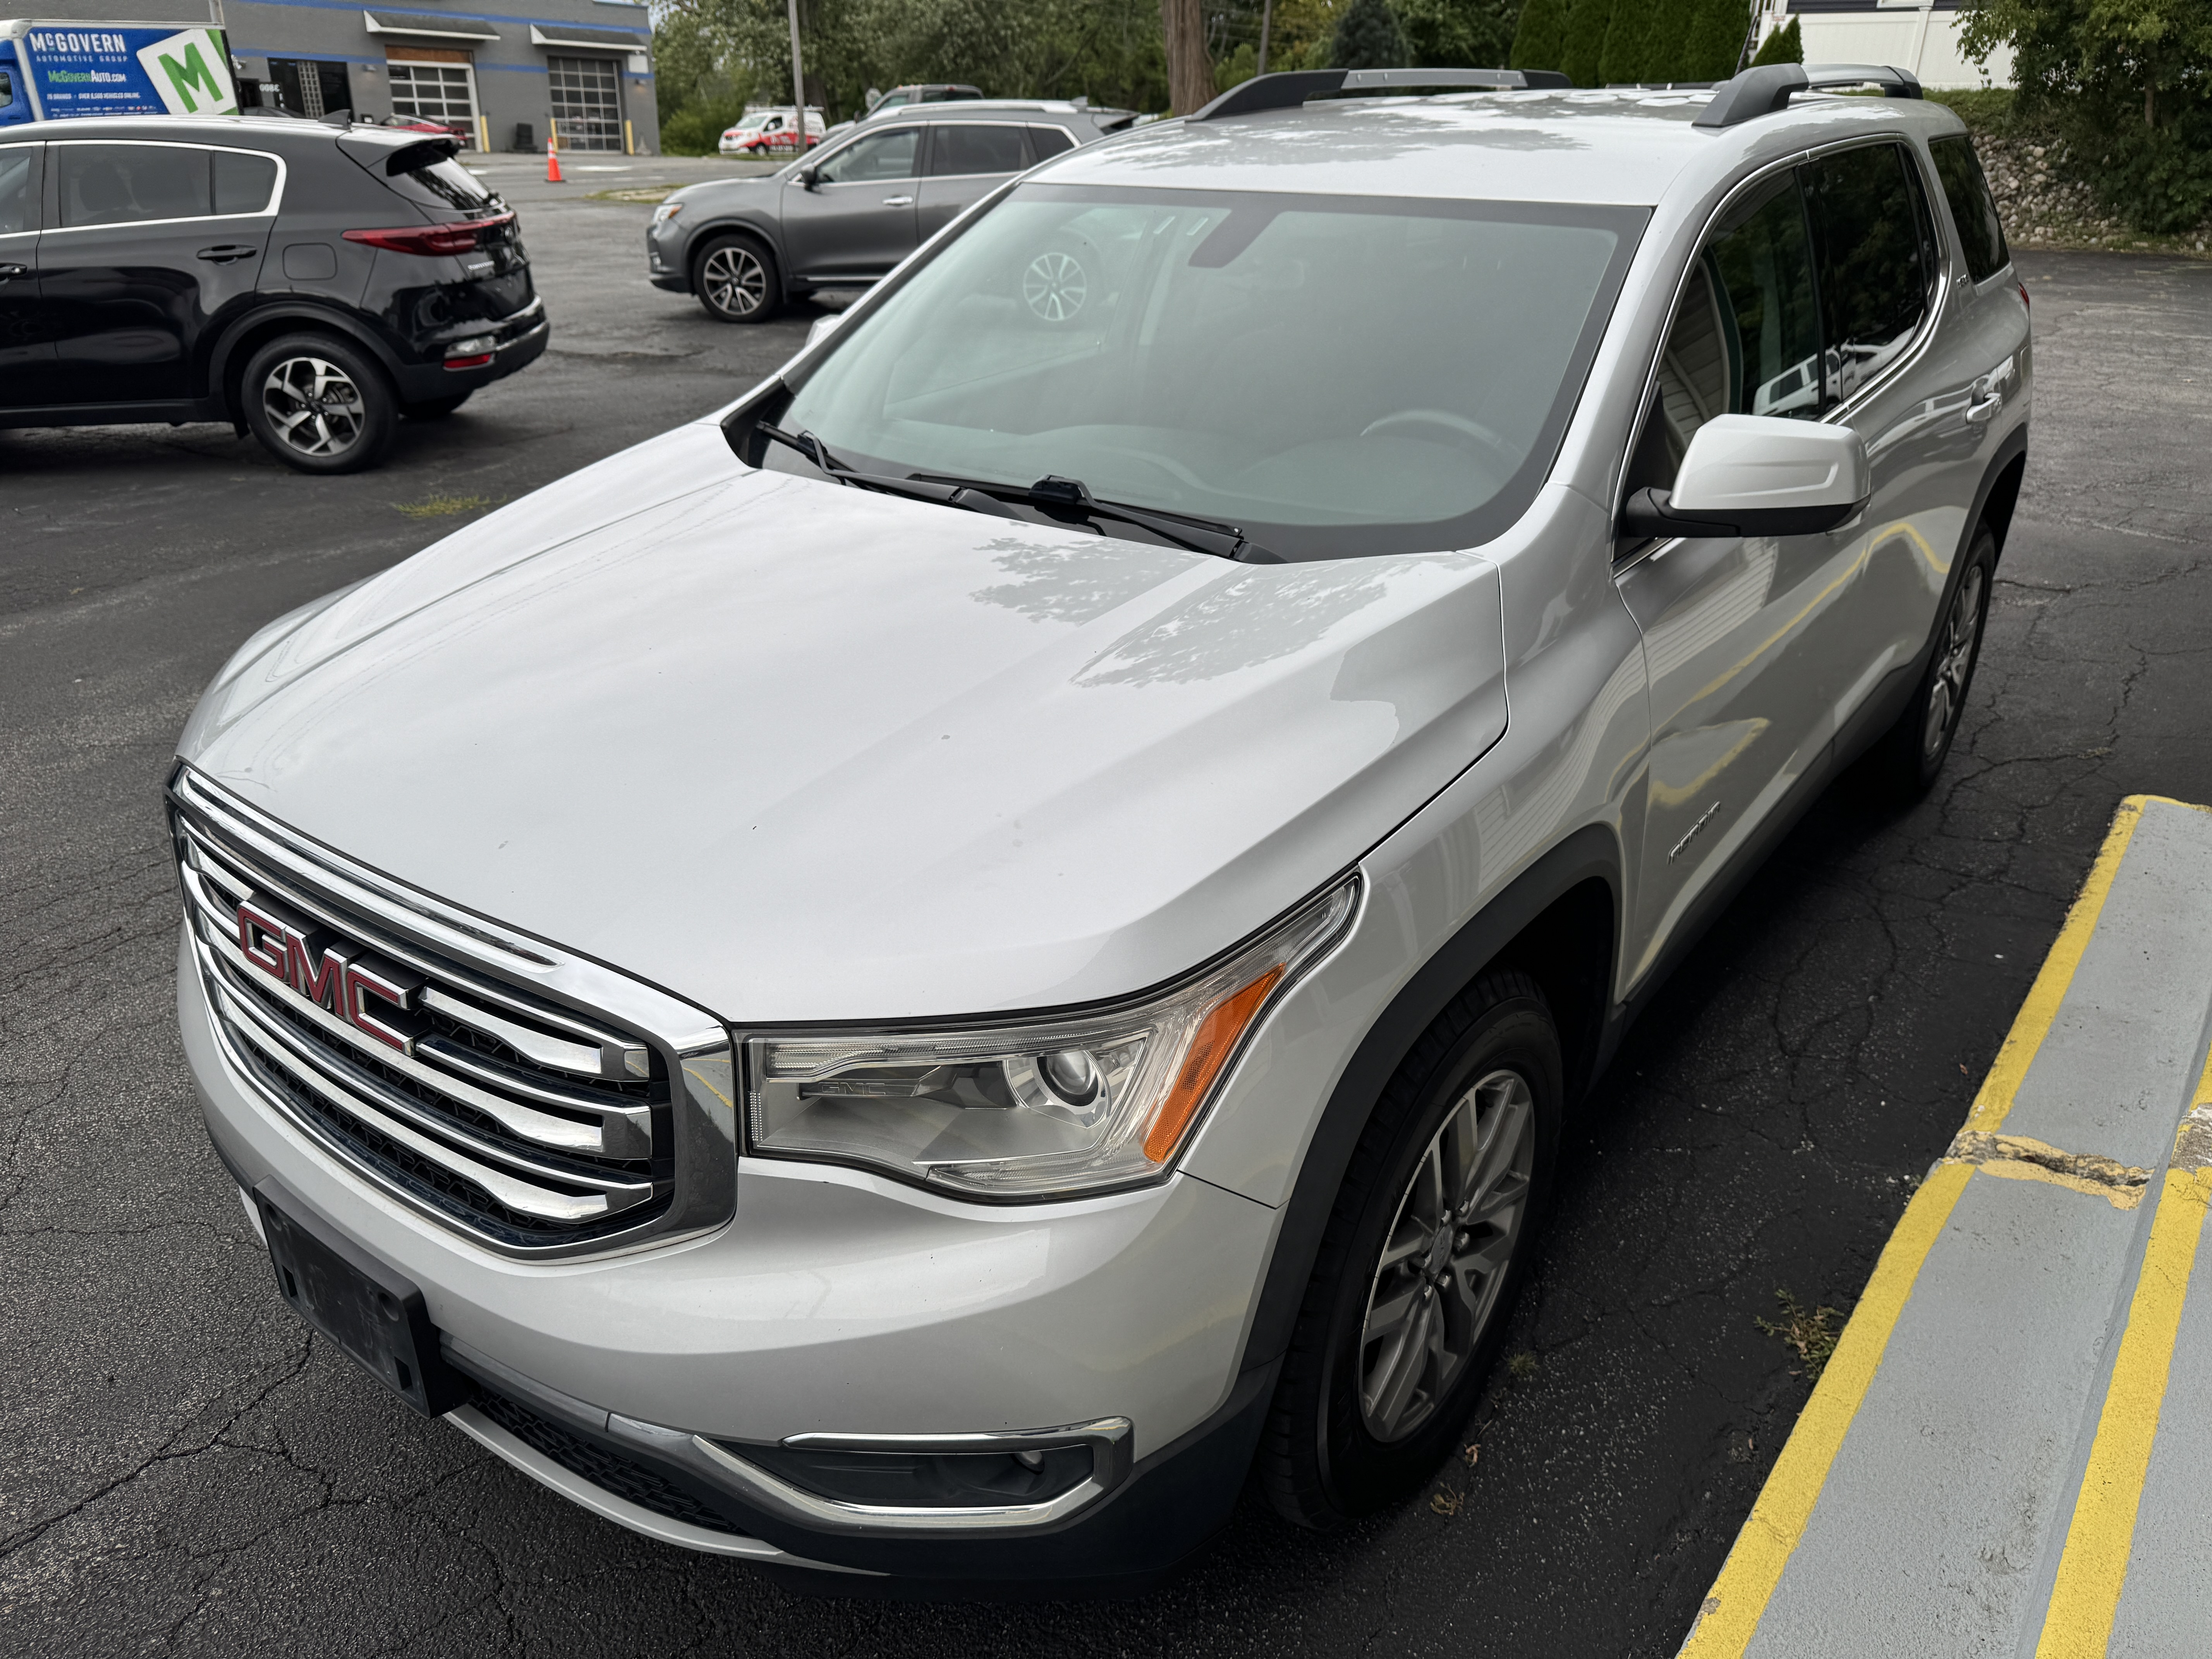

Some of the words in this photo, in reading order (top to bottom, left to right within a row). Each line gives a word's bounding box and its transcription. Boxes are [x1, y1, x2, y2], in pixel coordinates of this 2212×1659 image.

[158, 43, 223, 113] M
[237, 900, 414, 1057] GMC
[818, 1082, 886, 1096] GMC
